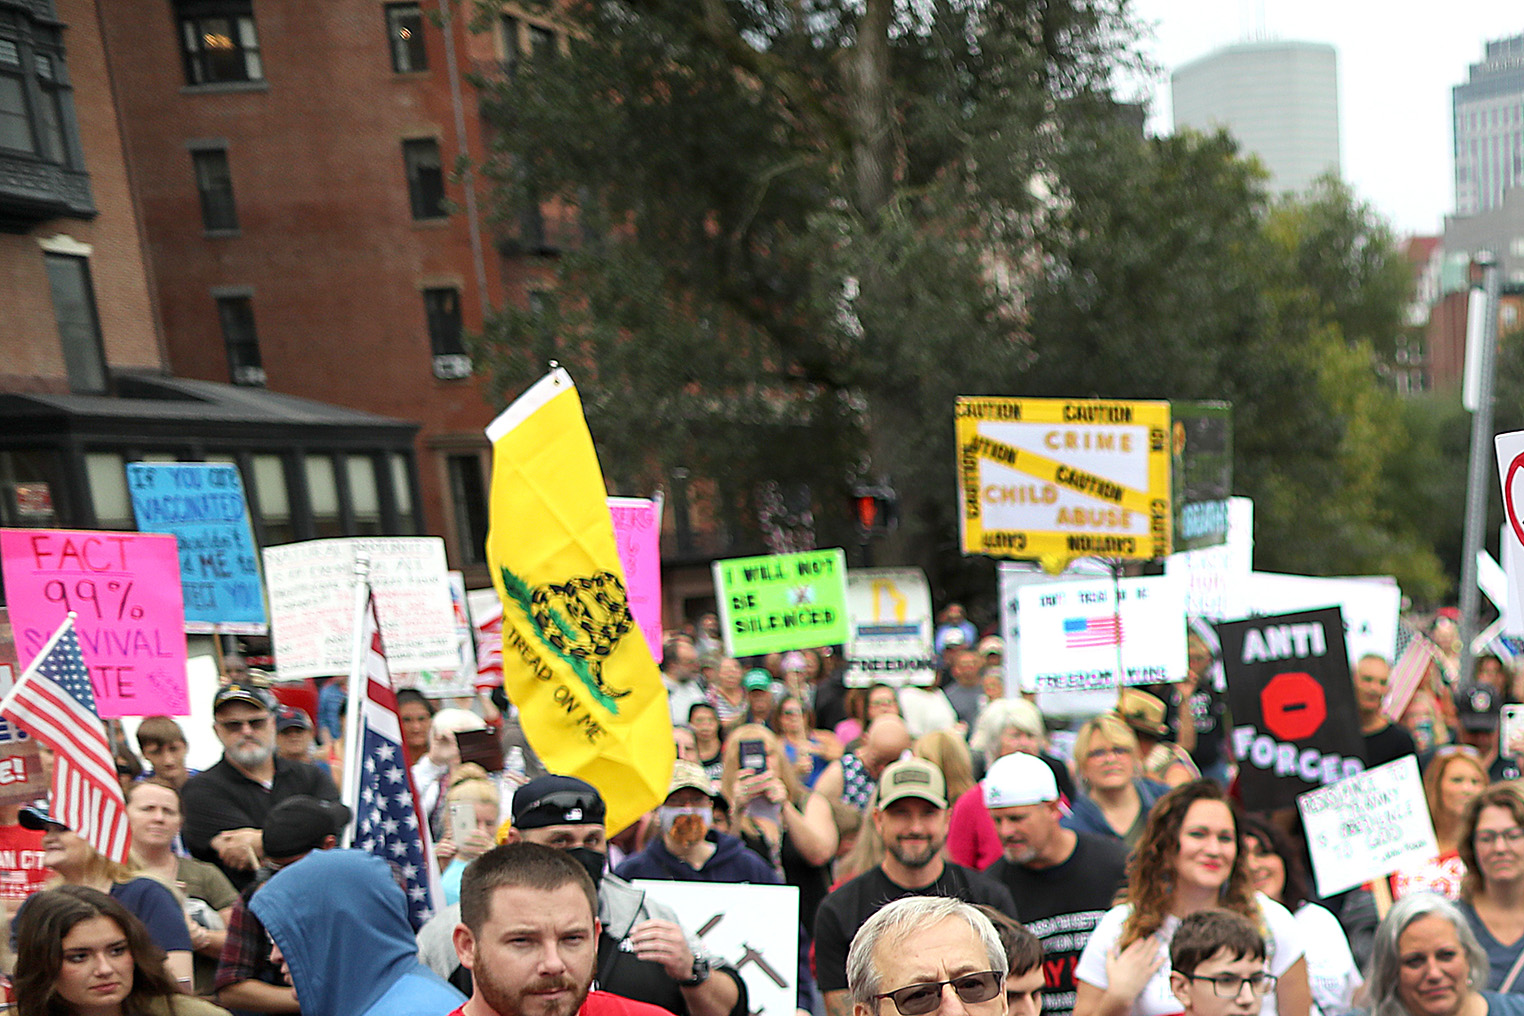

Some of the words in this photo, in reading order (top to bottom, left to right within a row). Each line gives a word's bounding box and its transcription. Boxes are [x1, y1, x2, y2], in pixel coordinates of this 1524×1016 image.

[1063, 405, 1133, 422] CAUTION
[1043, 430, 1134, 452] CRIME
[984, 484, 1058, 504] CHILD
[1056, 465, 1125, 502] CAUTION
[1056, 506, 1134, 528] ABUSE
[31, 536, 134, 572] FACT
[744, 564, 786, 583] WILL
[798, 558, 834, 577] NOT
[44, 580, 144, 621] 99%
[732, 594, 757, 610] BE
[735, 610, 836, 634] SILENCED
[24, 628, 174, 659] SVIVAL
[1242, 621, 1328, 664] ANTI
[507, 628, 554, 682] TREAD
[553, 685, 582, 715] ON
[576, 713, 609, 744] ME
[1231, 724, 1367, 786] FORCED
